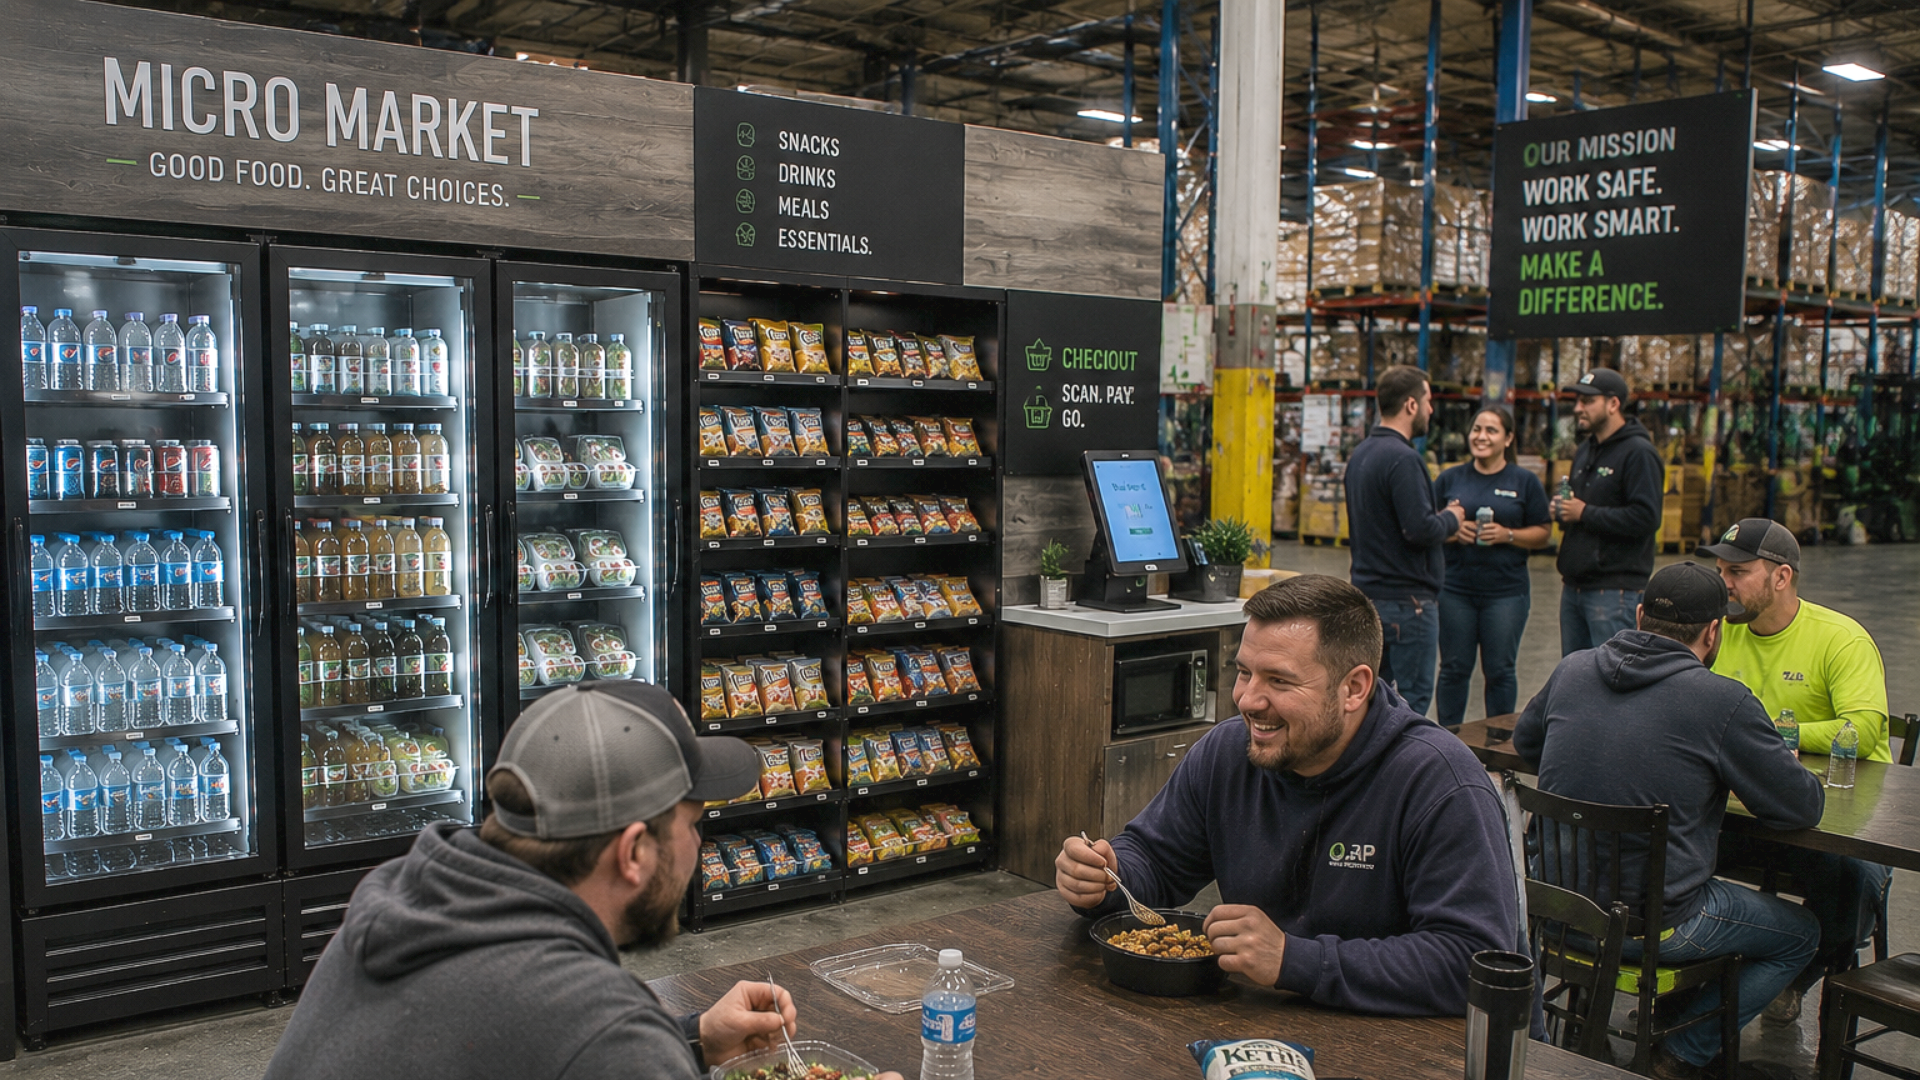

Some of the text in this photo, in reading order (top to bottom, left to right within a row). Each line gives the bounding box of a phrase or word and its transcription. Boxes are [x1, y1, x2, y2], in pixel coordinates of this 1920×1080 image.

[104, 56, 540, 167] MICRO MARKET
[779, 130, 840, 157] SNACKS
[1523, 126, 1676, 167] OUR MISSION
[149, 151, 510, 208] GOOD FOOD. GREAT CHOICES.
[779, 162, 836, 189] DRINKS
[1522, 166, 1662, 206] WORK SAFE.
[778, 195, 830, 220] MEALS
[1522, 205, 1680, 244] WORK SMART.
[778, 227, 873, 256] ESSENTIALS.
[1520, 249, 1604, 282] MAKE A
[1518, 281, 1664, 315] DIFFERENCE.
[1061, 408, 1086, 429] GO.
